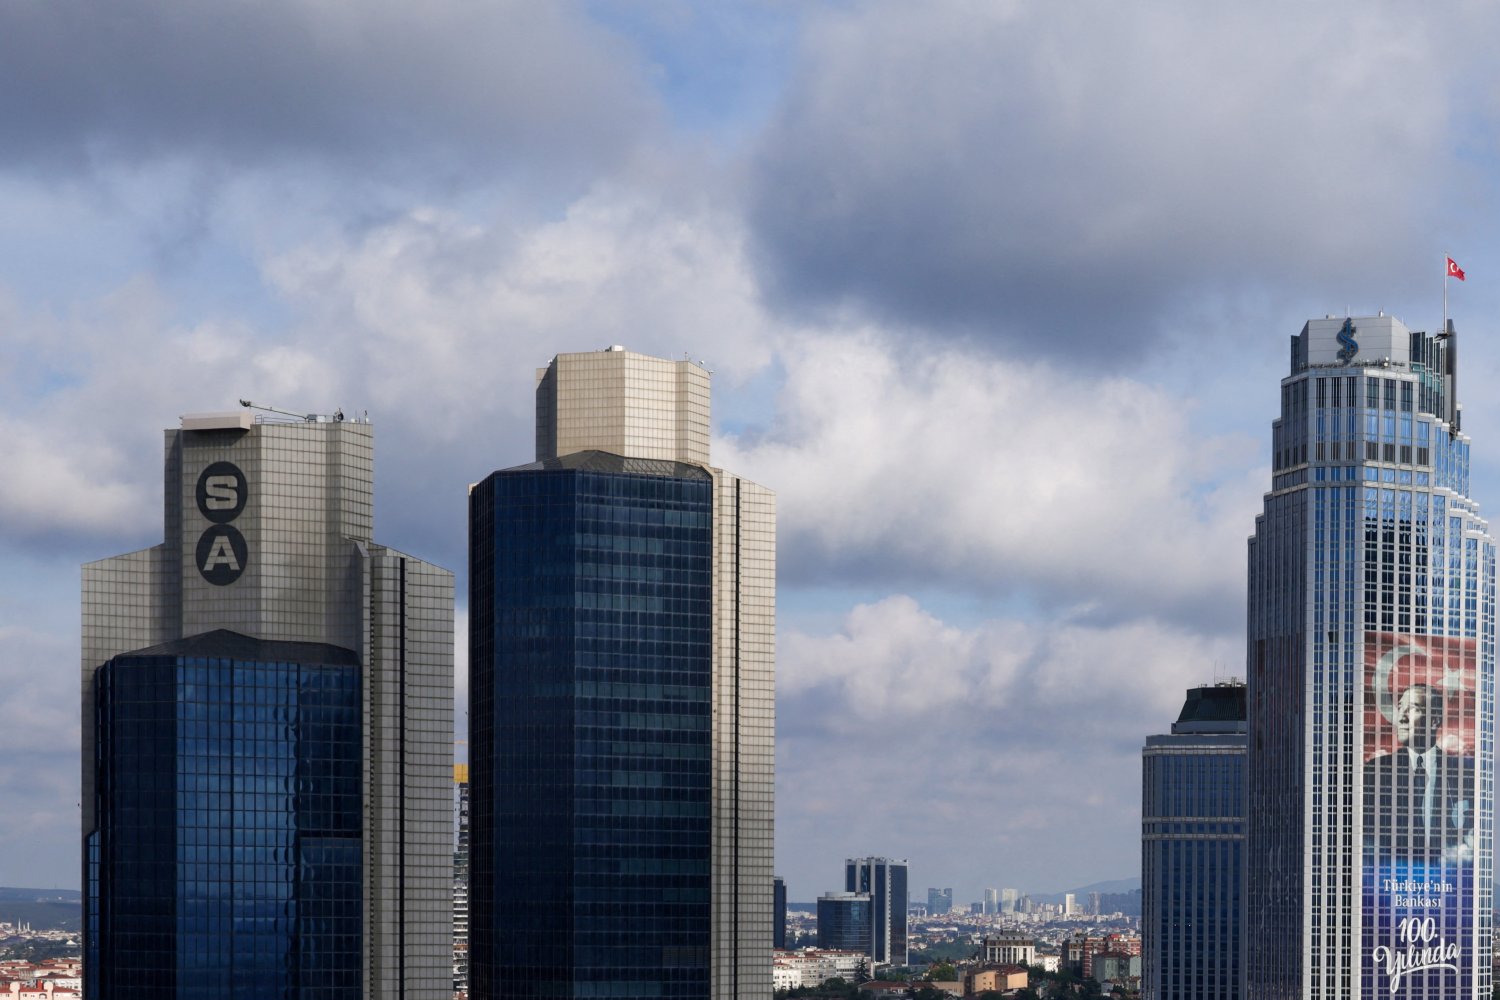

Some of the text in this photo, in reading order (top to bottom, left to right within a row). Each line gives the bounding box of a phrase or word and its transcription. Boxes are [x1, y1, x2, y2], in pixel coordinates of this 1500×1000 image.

[1395, 895, 1442, 907] Bankası
[1398, 917, 1438, 943] 100.
[1372, 938, 1462, 993] Yılında
